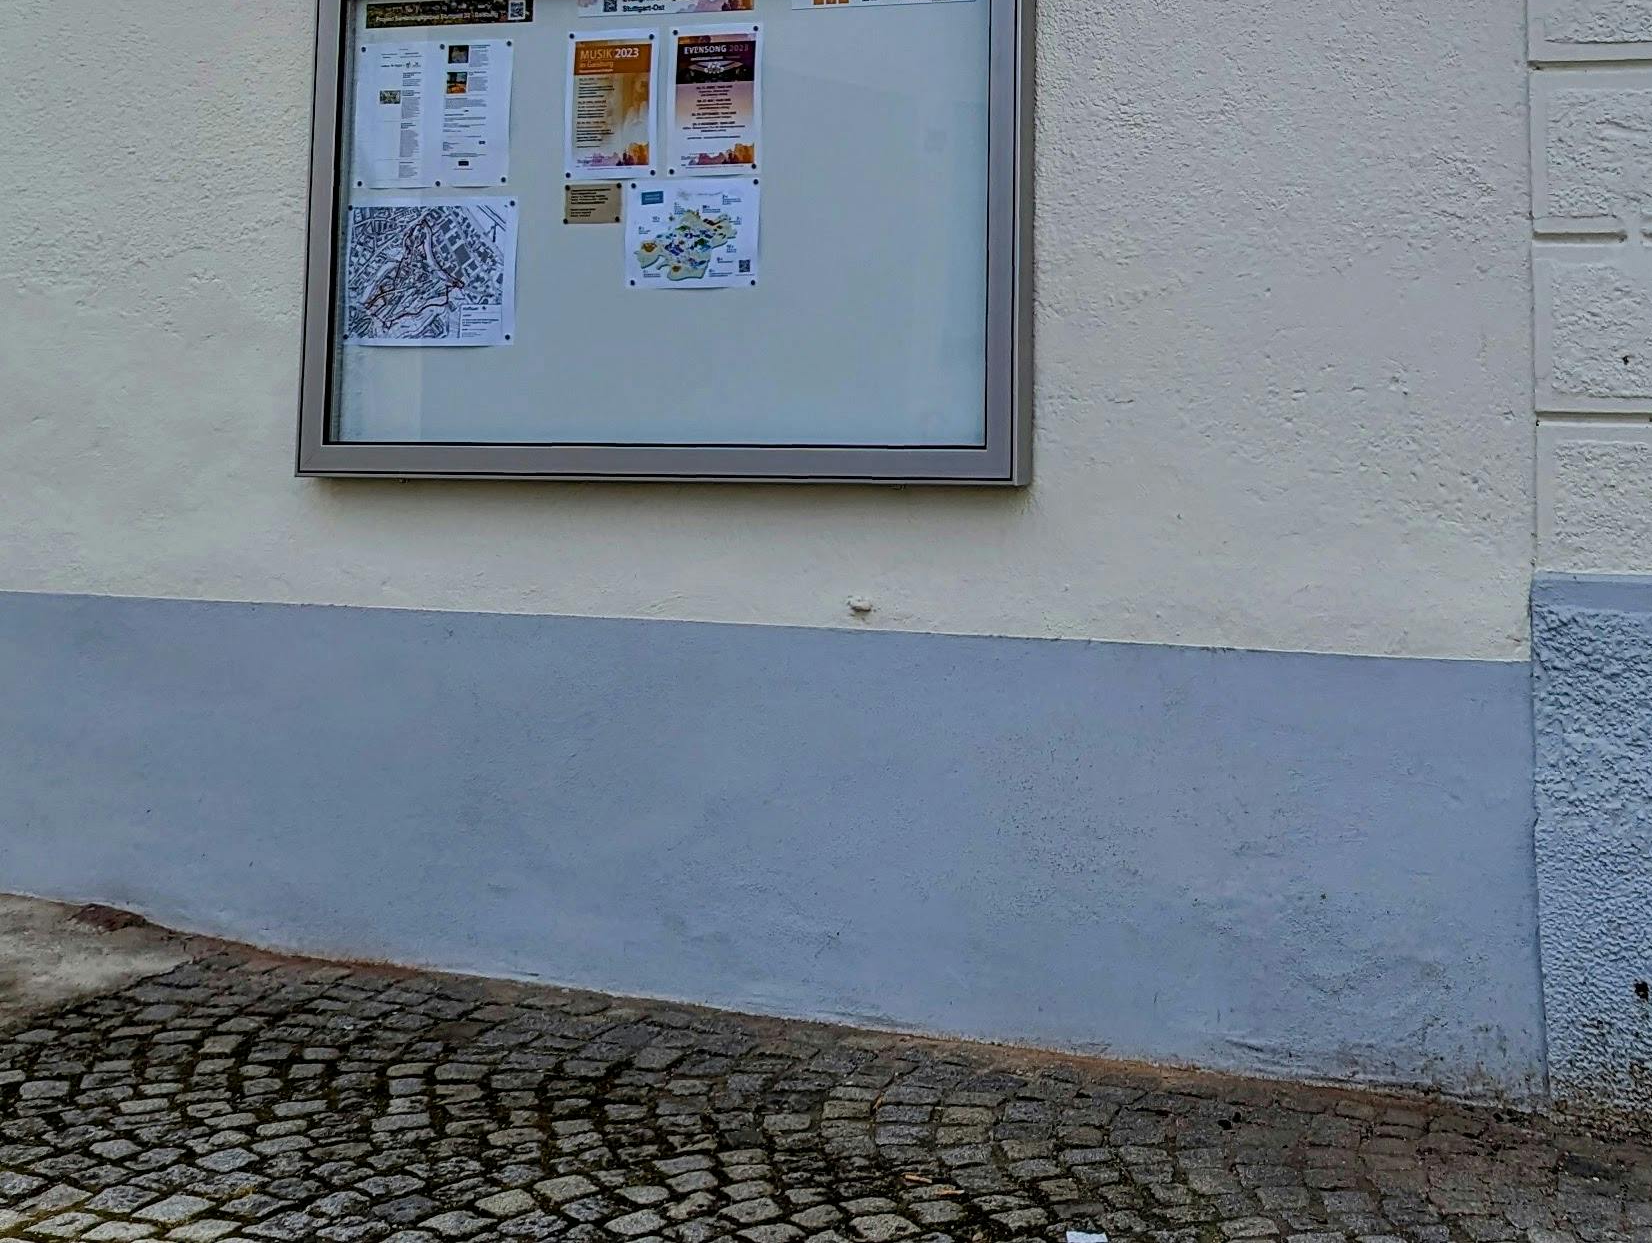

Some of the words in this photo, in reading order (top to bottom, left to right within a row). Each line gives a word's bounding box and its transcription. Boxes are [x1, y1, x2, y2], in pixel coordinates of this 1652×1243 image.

[580, 49, 612, 60] MUSIK
[614, 47, 640, 58] 2023
[684, 44, 727, 55] EVENSONG
[729, 44, 749, 53] 2023
